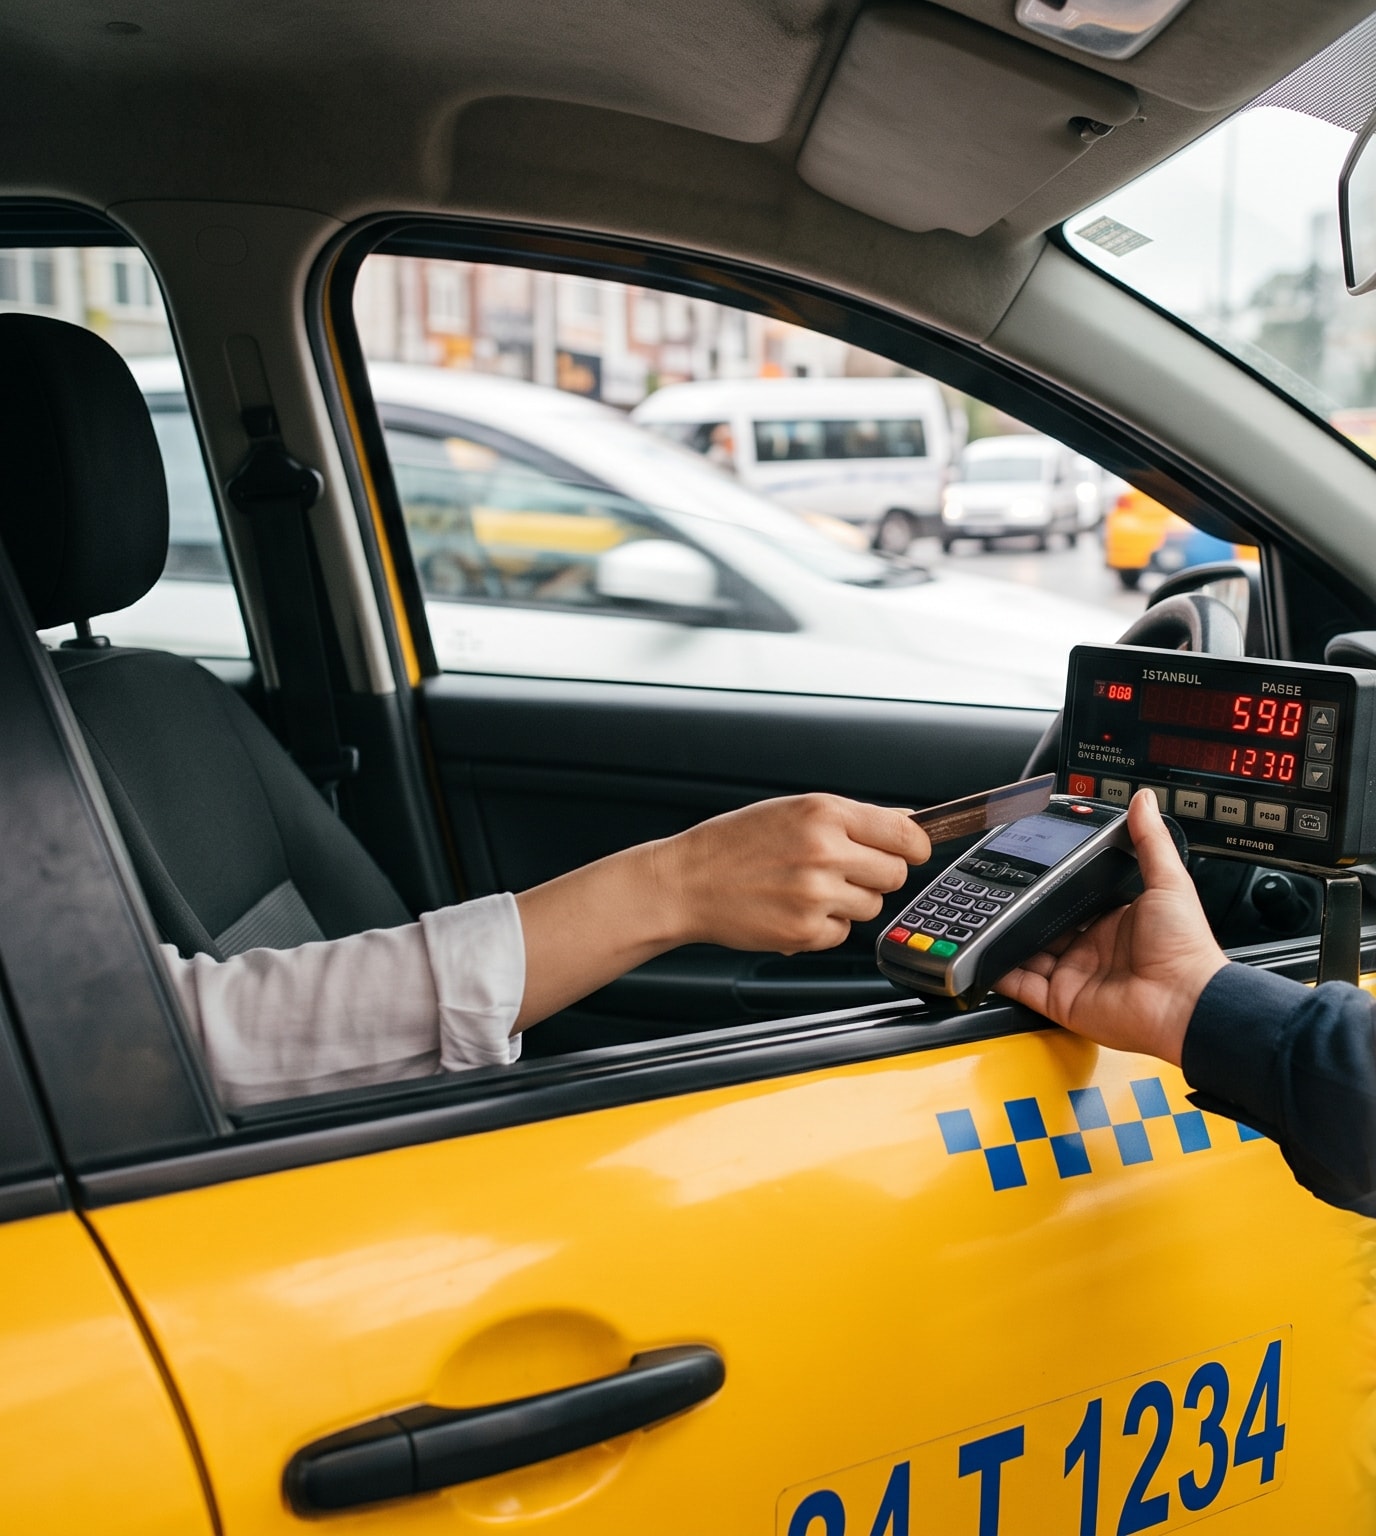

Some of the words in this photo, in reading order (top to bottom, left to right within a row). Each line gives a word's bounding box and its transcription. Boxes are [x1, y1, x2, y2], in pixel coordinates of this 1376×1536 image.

[1142, 669, 1202, 685] ISTANBUL
[1232, 696, 1302, 737] 590
[1229, 749, 1295, 781] 1230
[957, 1424, 1025, 1536] T
[1063, 1338, 1287, 1536] 1234
